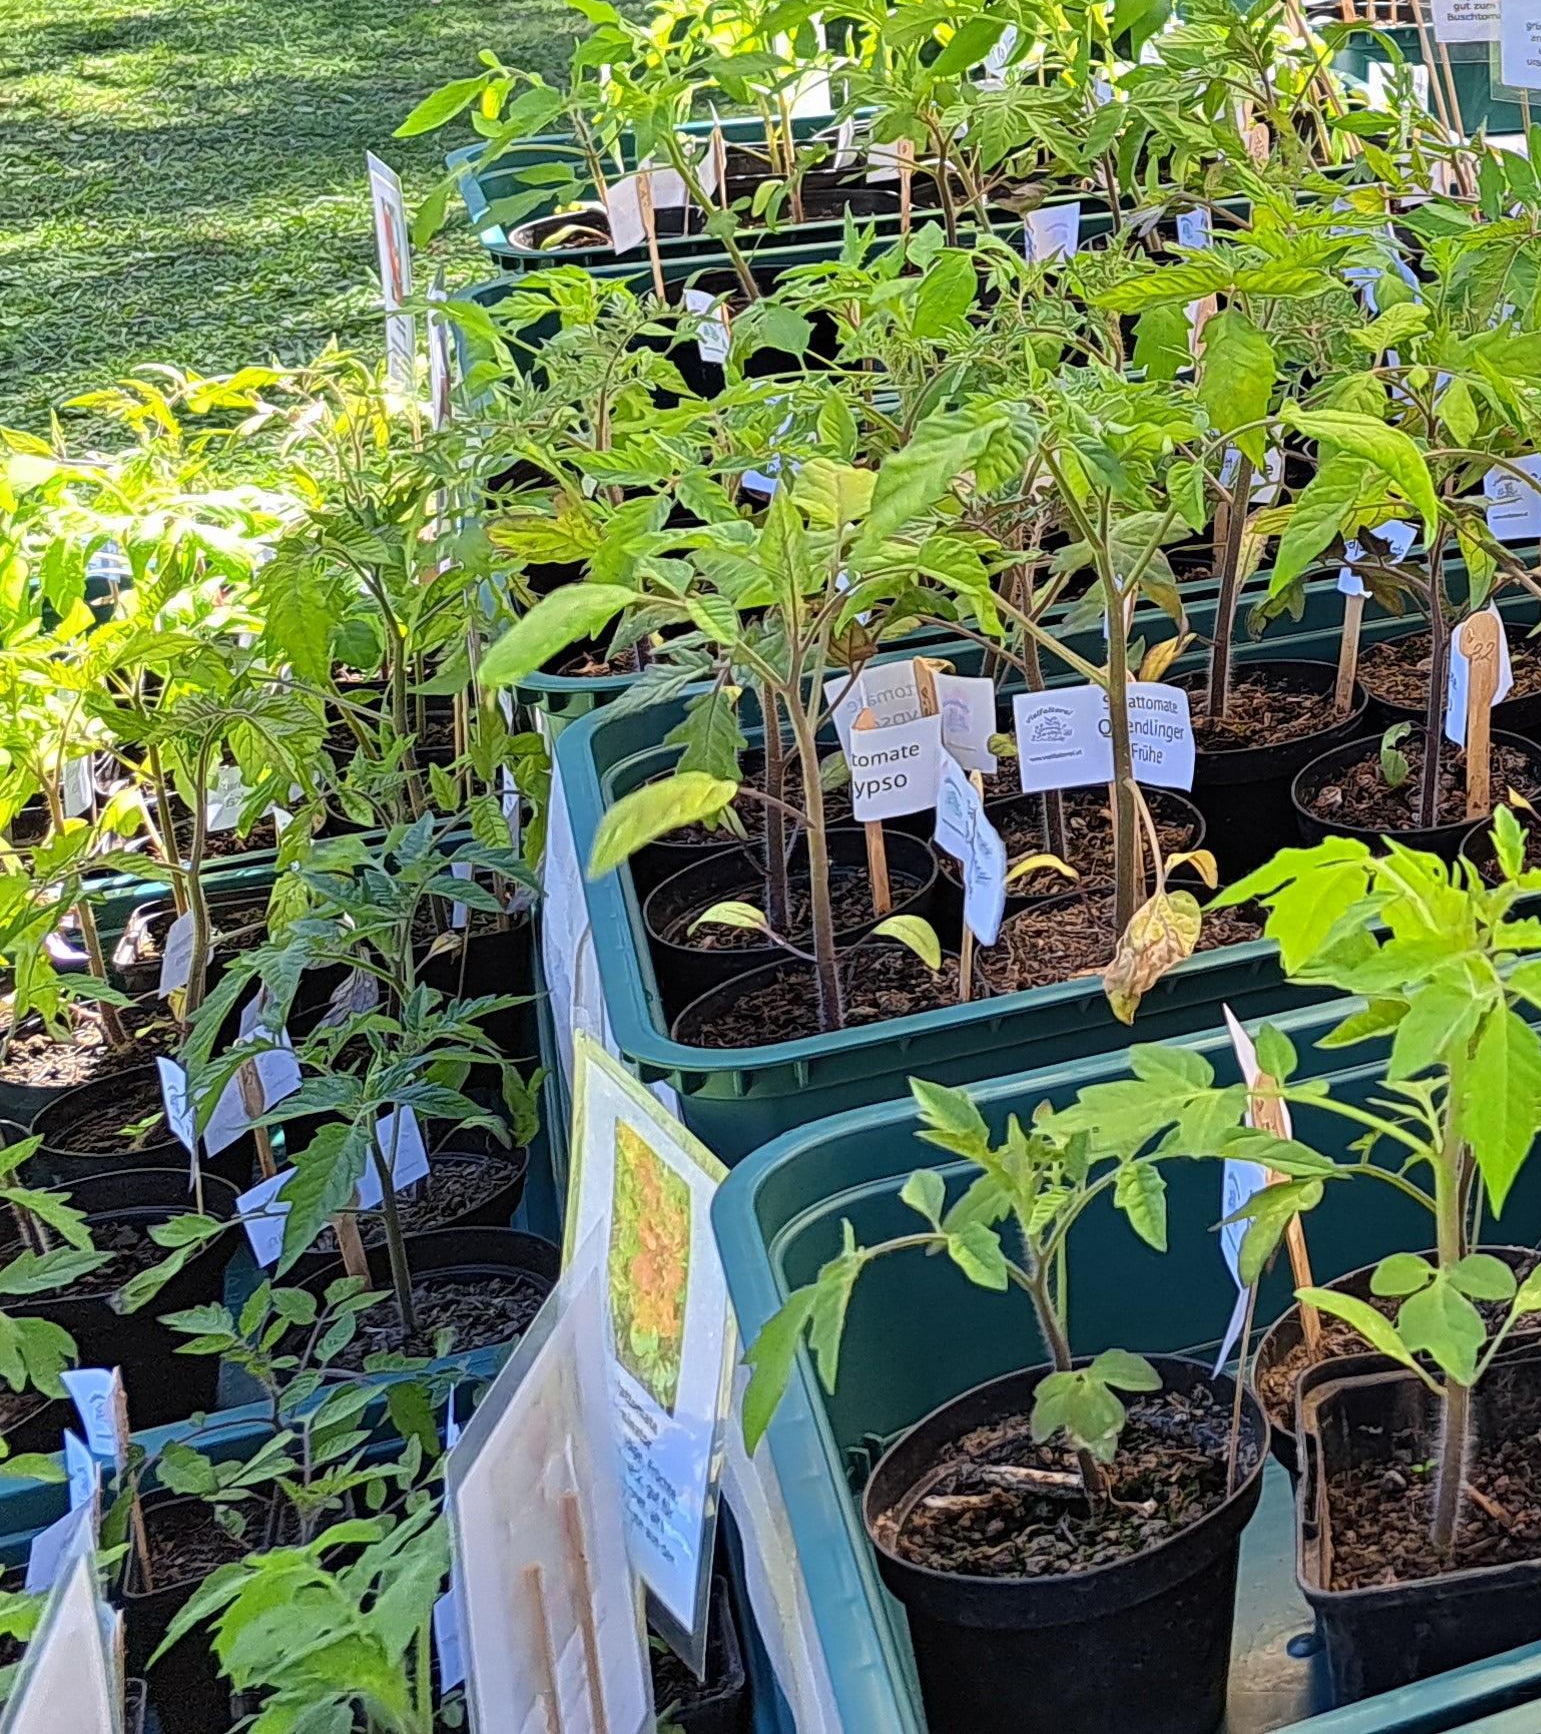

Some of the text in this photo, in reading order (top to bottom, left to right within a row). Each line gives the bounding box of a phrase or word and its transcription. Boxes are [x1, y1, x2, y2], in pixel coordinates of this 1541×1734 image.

[1453, 2, 1471, 12] gut
[1102, 694, 1179, 715] Sattomate
[1098, 718, 1185, 743] Qendlinger
[853, 771, 908, 800] ypso
